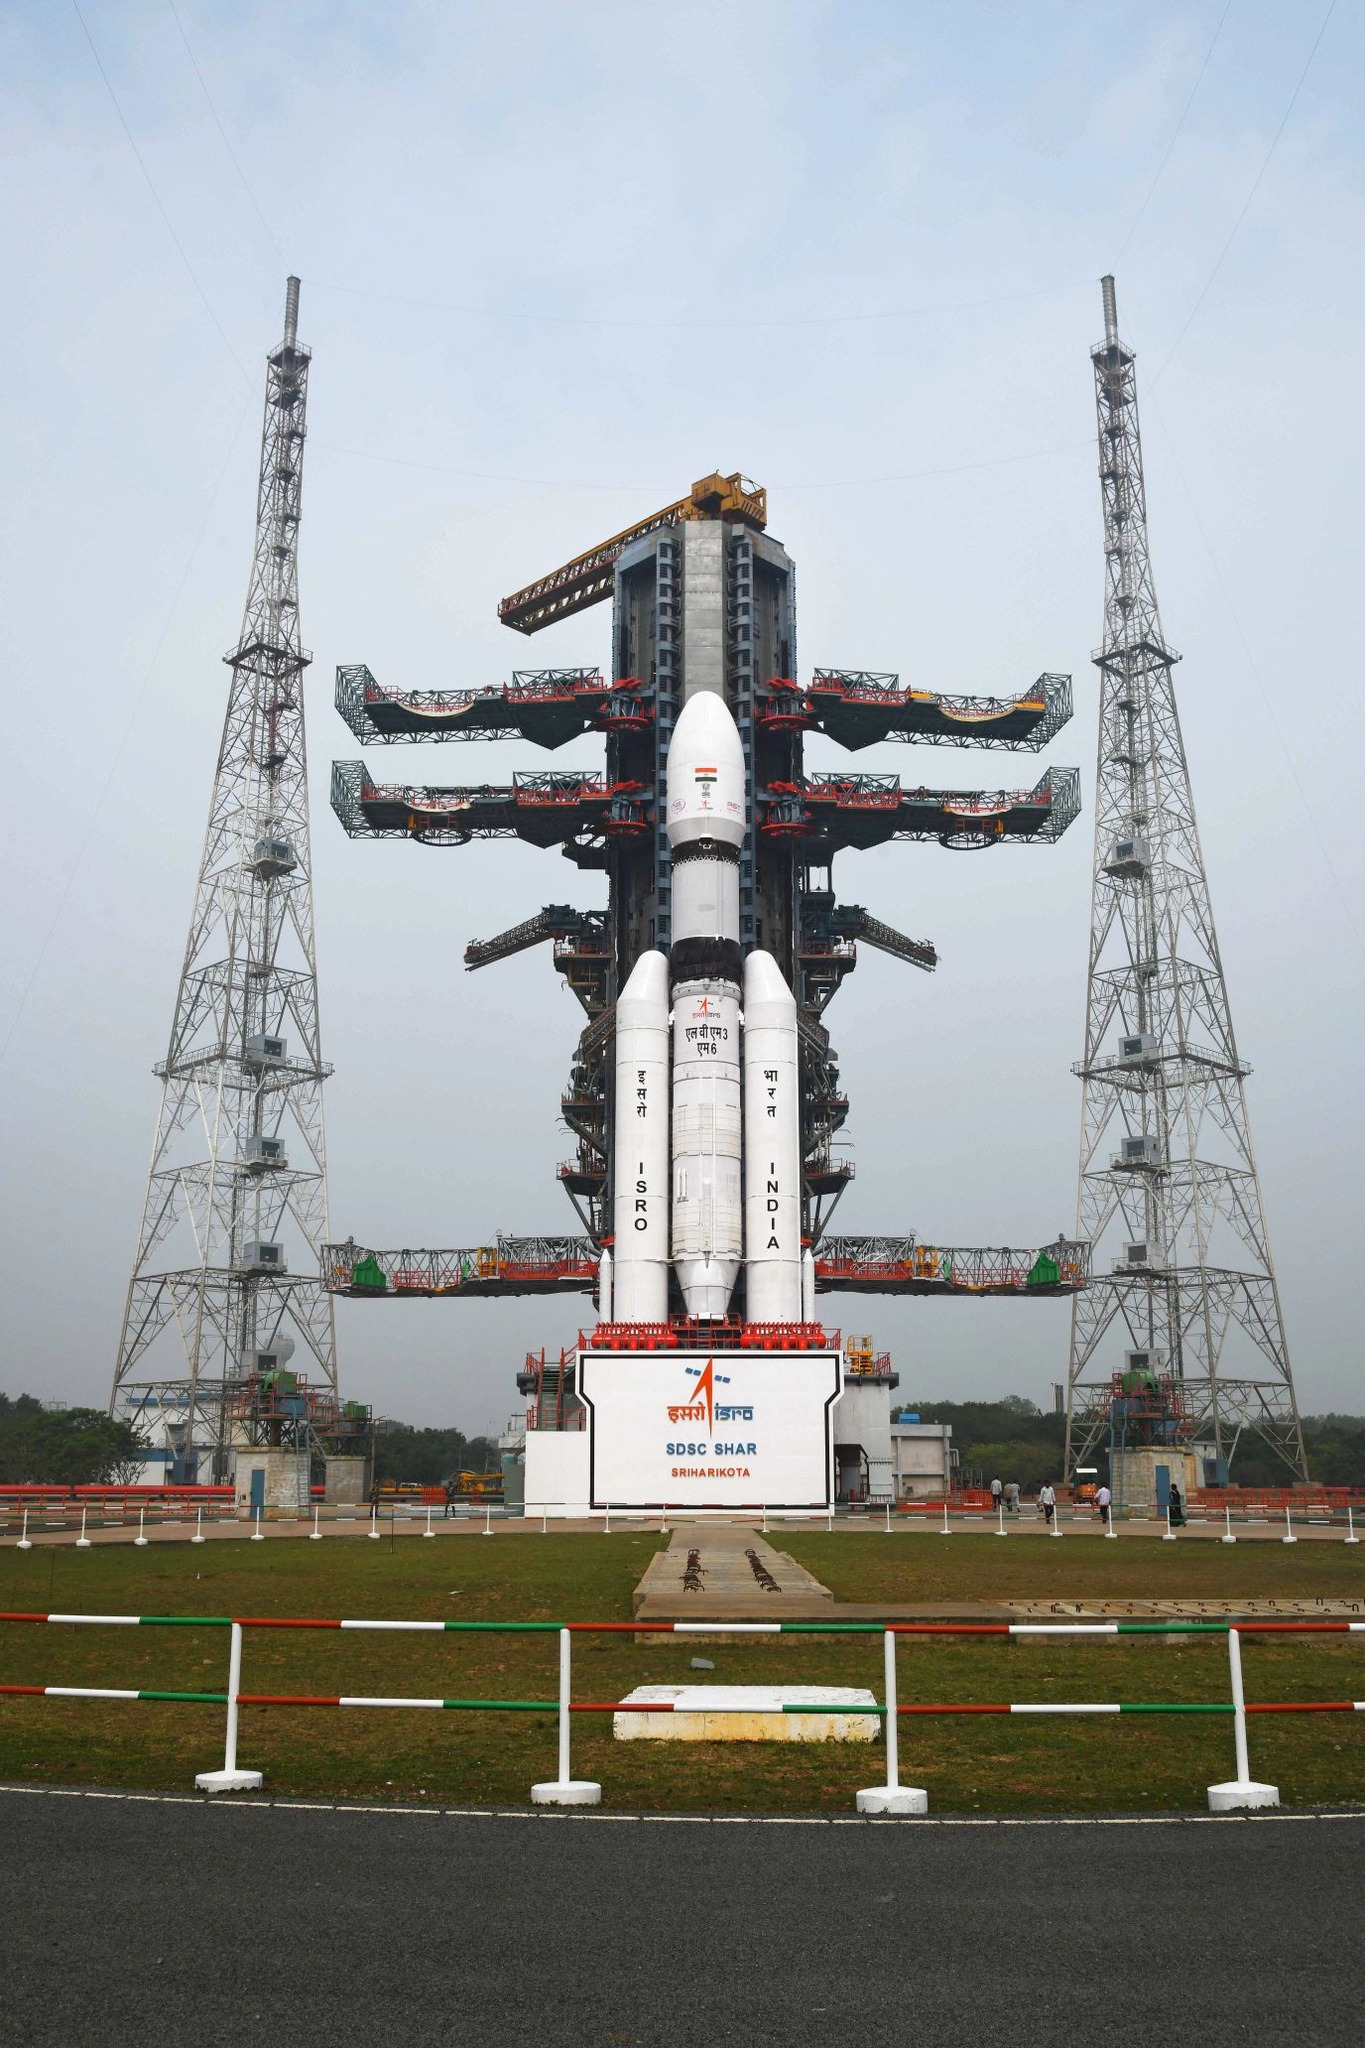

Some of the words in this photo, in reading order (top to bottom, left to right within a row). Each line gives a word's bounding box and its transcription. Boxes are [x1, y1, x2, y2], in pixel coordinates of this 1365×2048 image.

[763, 1070, 778, 1118] भारत
[634, 1162, 648, 1231] ISRO
[766, 1162, 780, 1249] INDIA
[667, 1401, 706, 1424] इसरो
[714, 1402, 754, 1421] isro
[666, 1443, 707, 1456] SDSC
[714, 1443, 757, 1456] SHAR
[671, 1467, 751, 1478] SRIHARIKOTA
